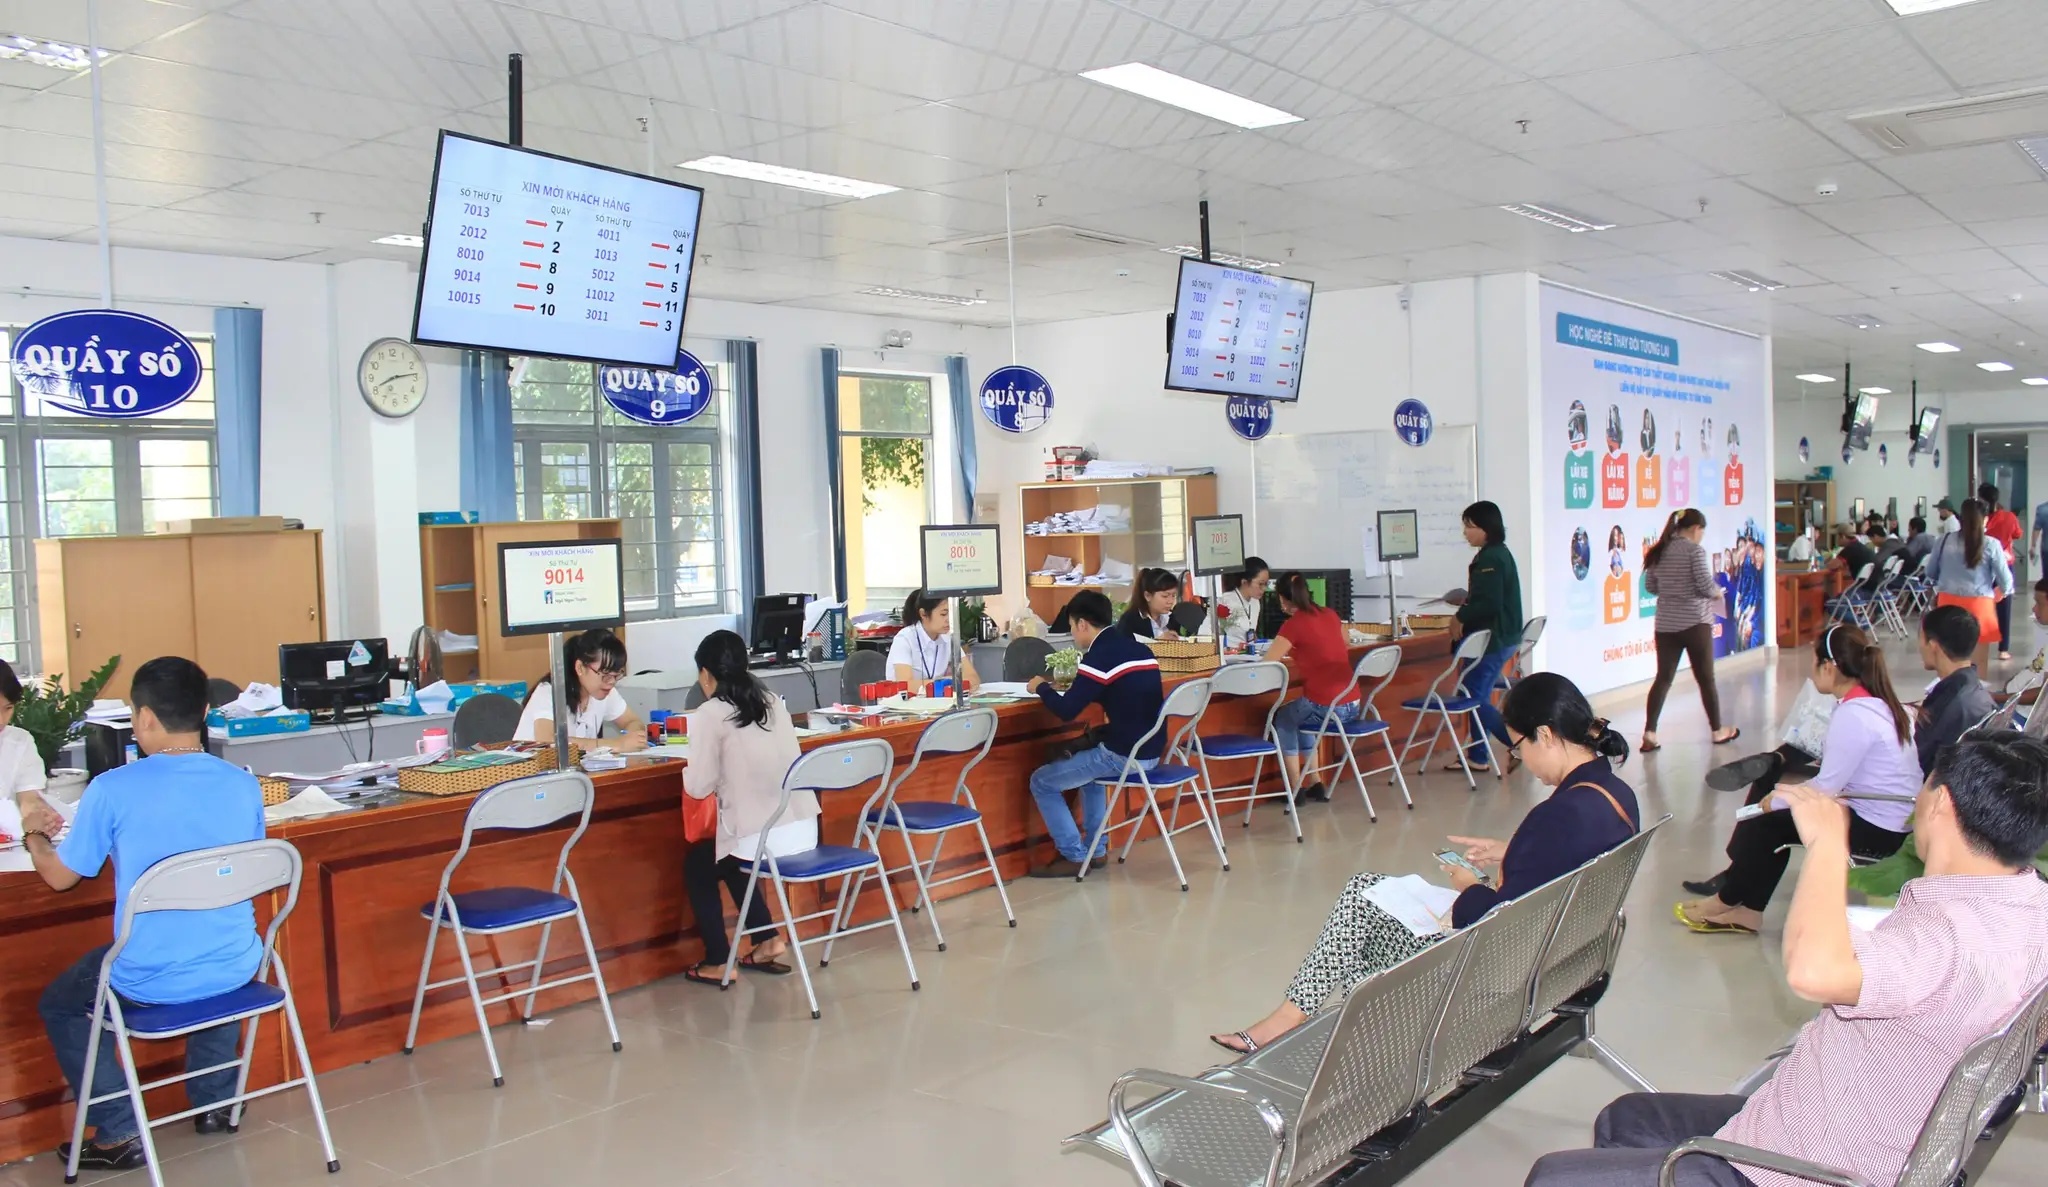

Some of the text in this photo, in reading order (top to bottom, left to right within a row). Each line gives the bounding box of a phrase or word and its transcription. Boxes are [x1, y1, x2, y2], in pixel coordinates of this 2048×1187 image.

[460, 187, 471, 197] SỐ
[521, 181, 630, 212] XIN MỜI KHÁCH HÀNG
[463, 203, 564, 233] 7013 7
[460, 225, 560, 254] 2012 2
[597, 228, 684, 255] 4011 4
[456, 246, 557, 275] 8010 8
[594, 248, 680, 274] 1013 1
[453, 268, 554, 295] 9014 9
[591, 269, 678, 293] 5012 5
[447, 290, 556, 316] 10015 10
[585, 288, 678, 313] 11012 11
[1193, 291, 1243, 311] 7013 7
[585, 308, 672, 332] 3011 3
[1190, 310, 1240, 328] 2012 2
[1187, 329, 1237, 346] 8010 8
[1568, 323, 1584, 342] HỌC
[1613, 333, 1630, 349] THAY
[25, 335, 182, 378] QUẦY SỐ
[378, 351, 384, 360] 11
[388, 348, 396, 357] 12
[401, 352, 405, 360] 1
[1185, 347, 1235, 364] 9014 9
[1250, 355, 1266, 367] 11012
[370, 361, 379, 370] 10
[409, 361, 415, 370] 2
[1181, 365, 1235, 382] 10015 10
[368, 373, 375, 383] 9
[412, 373, 418, 382] 3
[674, 368, 701, 395] SỐ
[90, 384, 139, 410] 10
[372, 385, 379, 396] 8
[410, 385, 415, 394] 4
[984, 382, 1047, 409] QUẦY SỐ
[382, 394, 388, 404] 7
[392, 398, 398, 408] 6
[403, 394, 409, 404] 5
[650, 399, 667, 419] 9
[1229, 397, 1269, 420] QUẦY SỐ
[1014, 411, 1025, 428] 8
[1396, 410, 1429, 429] QUẦY SỐ
[1247, 422, 1256, 436] 7
[1411, 431, 1418, 443] 6
[1211, 532, 1228, 544] 7013
[950, 545, 976, 558] 8010
[544, 567, 585, 586] 9014
